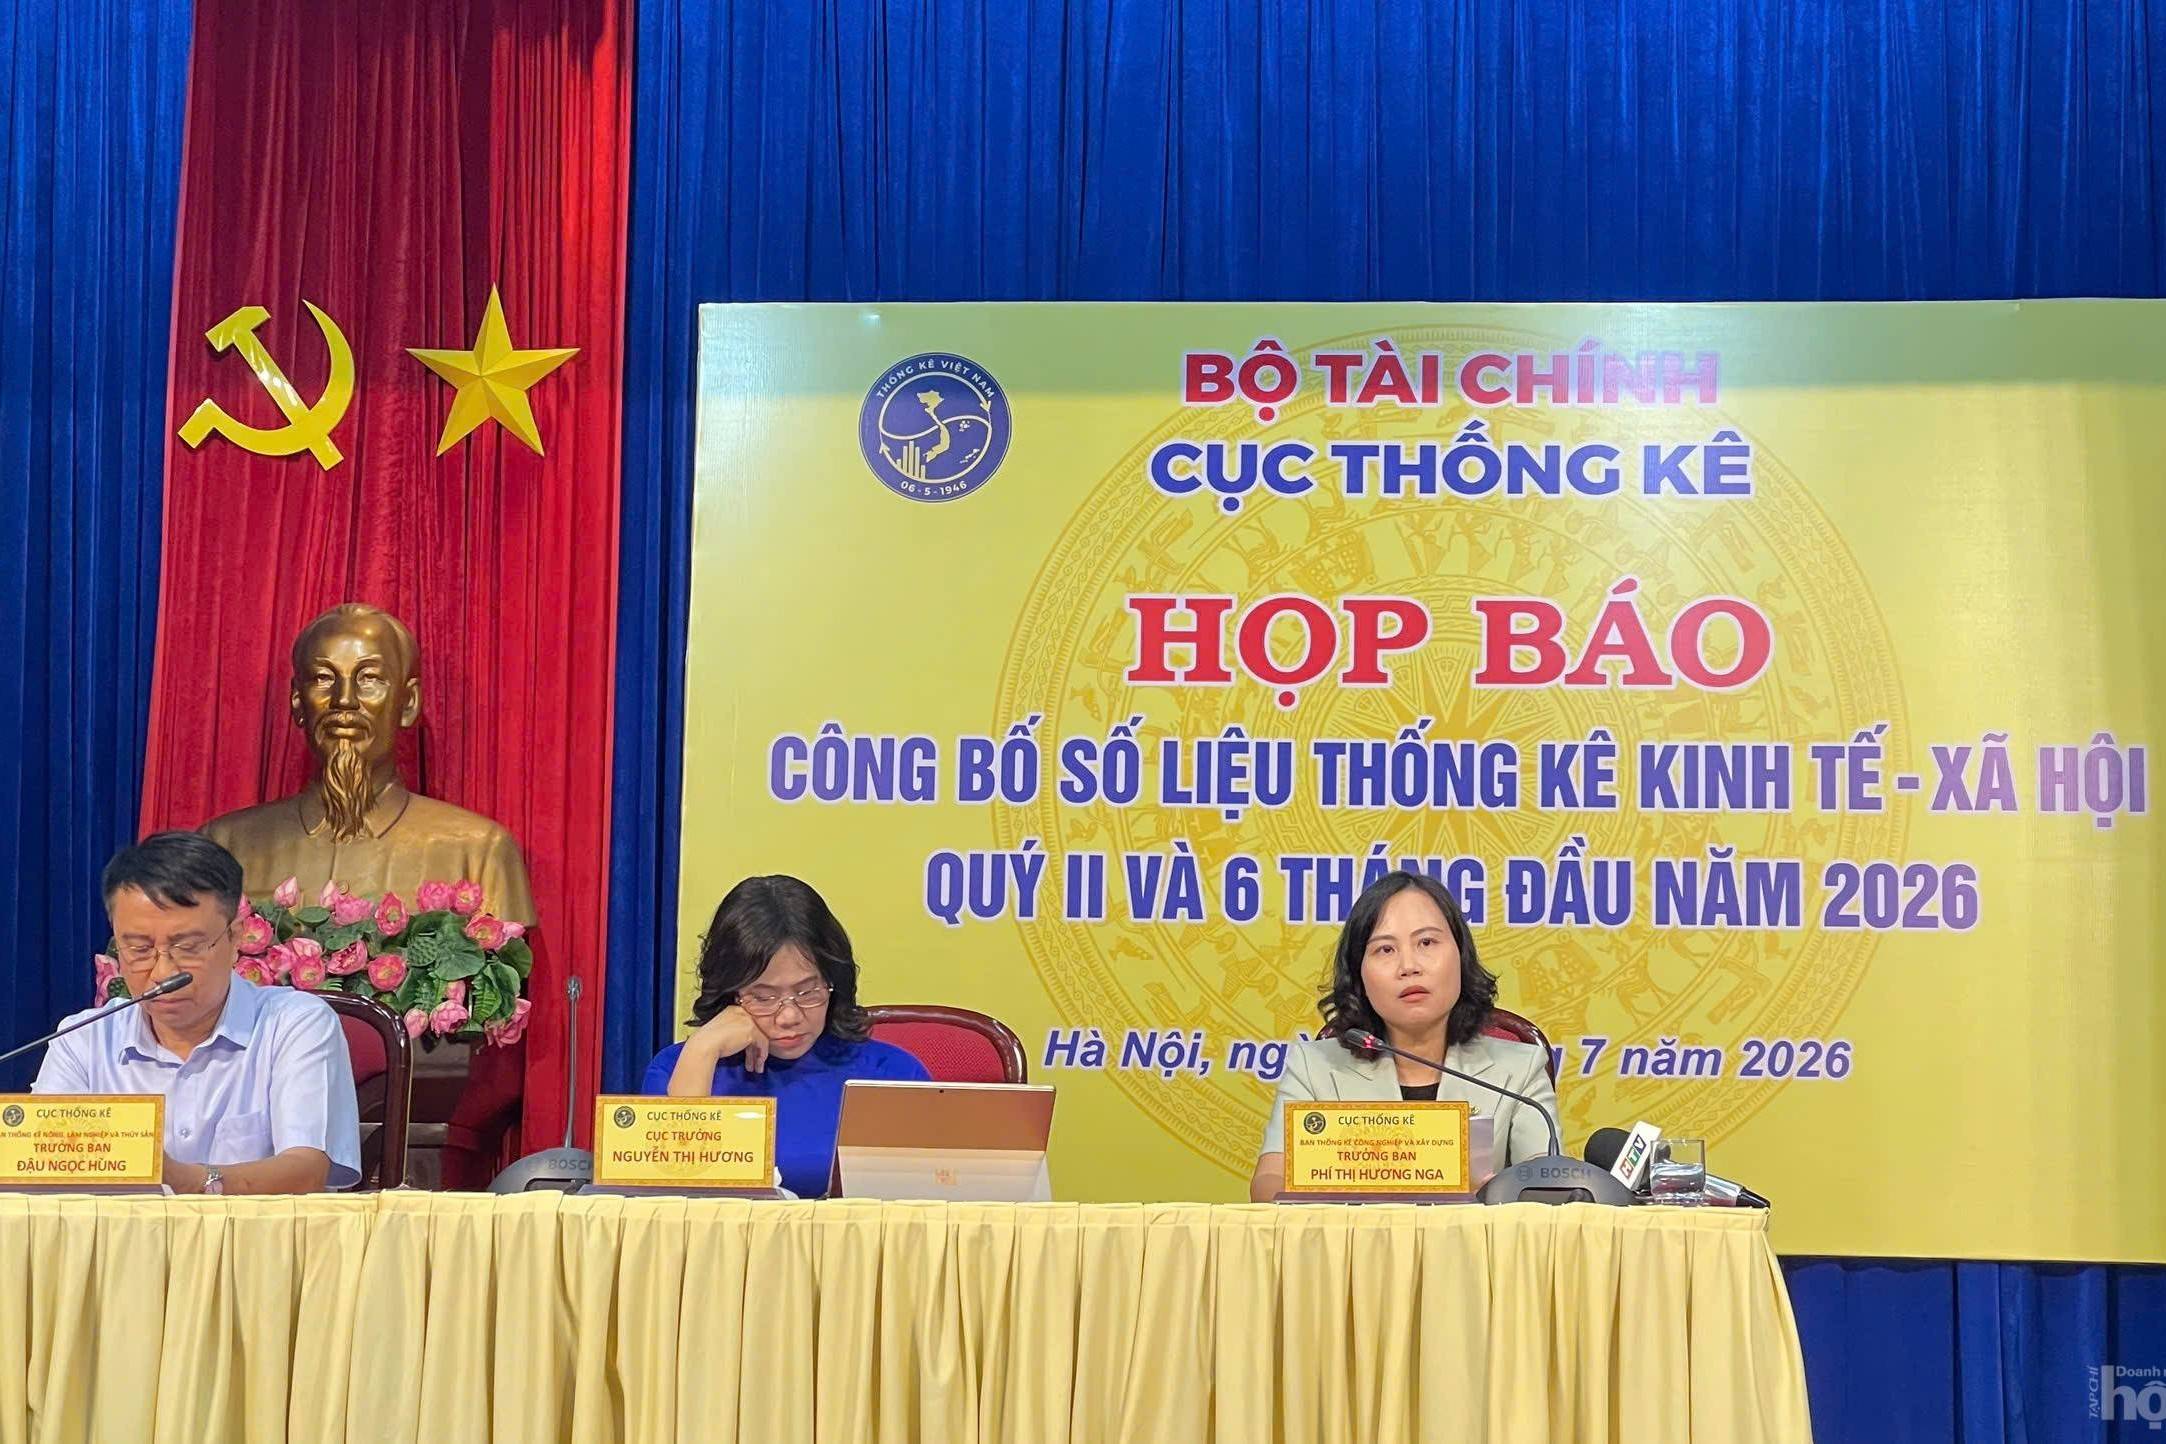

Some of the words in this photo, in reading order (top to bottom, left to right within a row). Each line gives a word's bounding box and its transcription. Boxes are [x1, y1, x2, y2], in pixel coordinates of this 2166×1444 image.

[919, 359, 934, 370] KÊ
[941, 360, 970, 374] VIỆT
[972, 373, 995, 397] NAM
[1186, 340, 1297, 421] BỘ
[1315, 340, 1438, 403] TÀI
[1460, 340, 1718, 404] CHÍNH
[1151, 443, 1314, 511] CỤC
[1331, 420, 1619, 495] THỐNG
[1644, 431, 1751, 494] KÊ
[1128, 597, 1428, 707] HỌP
[1476, 578, 1770, 687] BÁO
[771, 724, 936, 801] CÔNG
[959, 716, 1039, 802] BỐ
[1061, 717, 1145, 803] SỐ
[1163, 727, 1291, 819] LIỆU
[1315, 719, 1516, 807] THỐNG
[1541, 730, 1616, 807] KÊ
[1641, 745, 1789, 809] KINH
[1933, 733, 2015, 811] XÃ
[2041, 734, 2145, 827] HỘI
[927, 840, 1044, 924] QUÝ
[1067, 855, 1103, 918] II
[1126, 842, 1203, 919] VÀ
[1225, 857, 1259, 921] 6
[1281, 844, 1484, 924] THG
[1506, 837, 1630, 925] ĐẦU
[1656, 847, 1800, 926] NĂM
[1824, 863, 1977, 929] 2026
[1046, 1030, 1105, 1067] Hà
[1121, 1032, 1209, 1078] Nội,
[1582, 1039, 1606, 1074] 7
[1621, 1039, 1721, 1076] năm
[1741, 1041, 1851, 1078] 2026
[36, 1109, 59, 1119] CỤC
[61, 1106, 96, 1118] THỐNG
[100, 1107, 111, 1117] KÊ
[647, 1112, 667, 1121] CỤC
[671, 1109, 707, 1121] THỐNG
[710, 1110, 721, 1120] KÊ
[1338, 1116, 1360, 1127] CỤC
[1363, 1113, 1399, 1125] THỐNG
[1403, 1114, 1414, 1125] KÊ
[646, 1131, 668, 1142] CỤC
[672, 1128, 721, 1141] TRƯỞNG
[34, 1140, 84, 1153] TRƯỞNG
[88, 1143, 111, 1153] BAN
[1337, 1148, 1389, 1161] TRƯỞNG
[1393, 1151, 1416, 1161] BAN
[613, 1146, 669, 1162] NGUYỄN
[673, 1151, 695, 1165] THỊ
[700, 1150, 754, 1163] HƯƠNG
[1619, 1134, 1647, 1180] HTV
[17, 1158, 44, 1174] ĐẬU
[48, 1160, 85, 1174] NGỌC
[88, 1158, 126, 1171] HÙNG
[1311, 1166, 1332, 1180] PHÍ
[1335, 1169, 1356, 1182] THỊ
[1359, 1168, 1411, 1180] HƯƠNG
[1415, 1169, 1444, 1180] NGA
[1540, 1167, 1591, 1179] BOSCH
